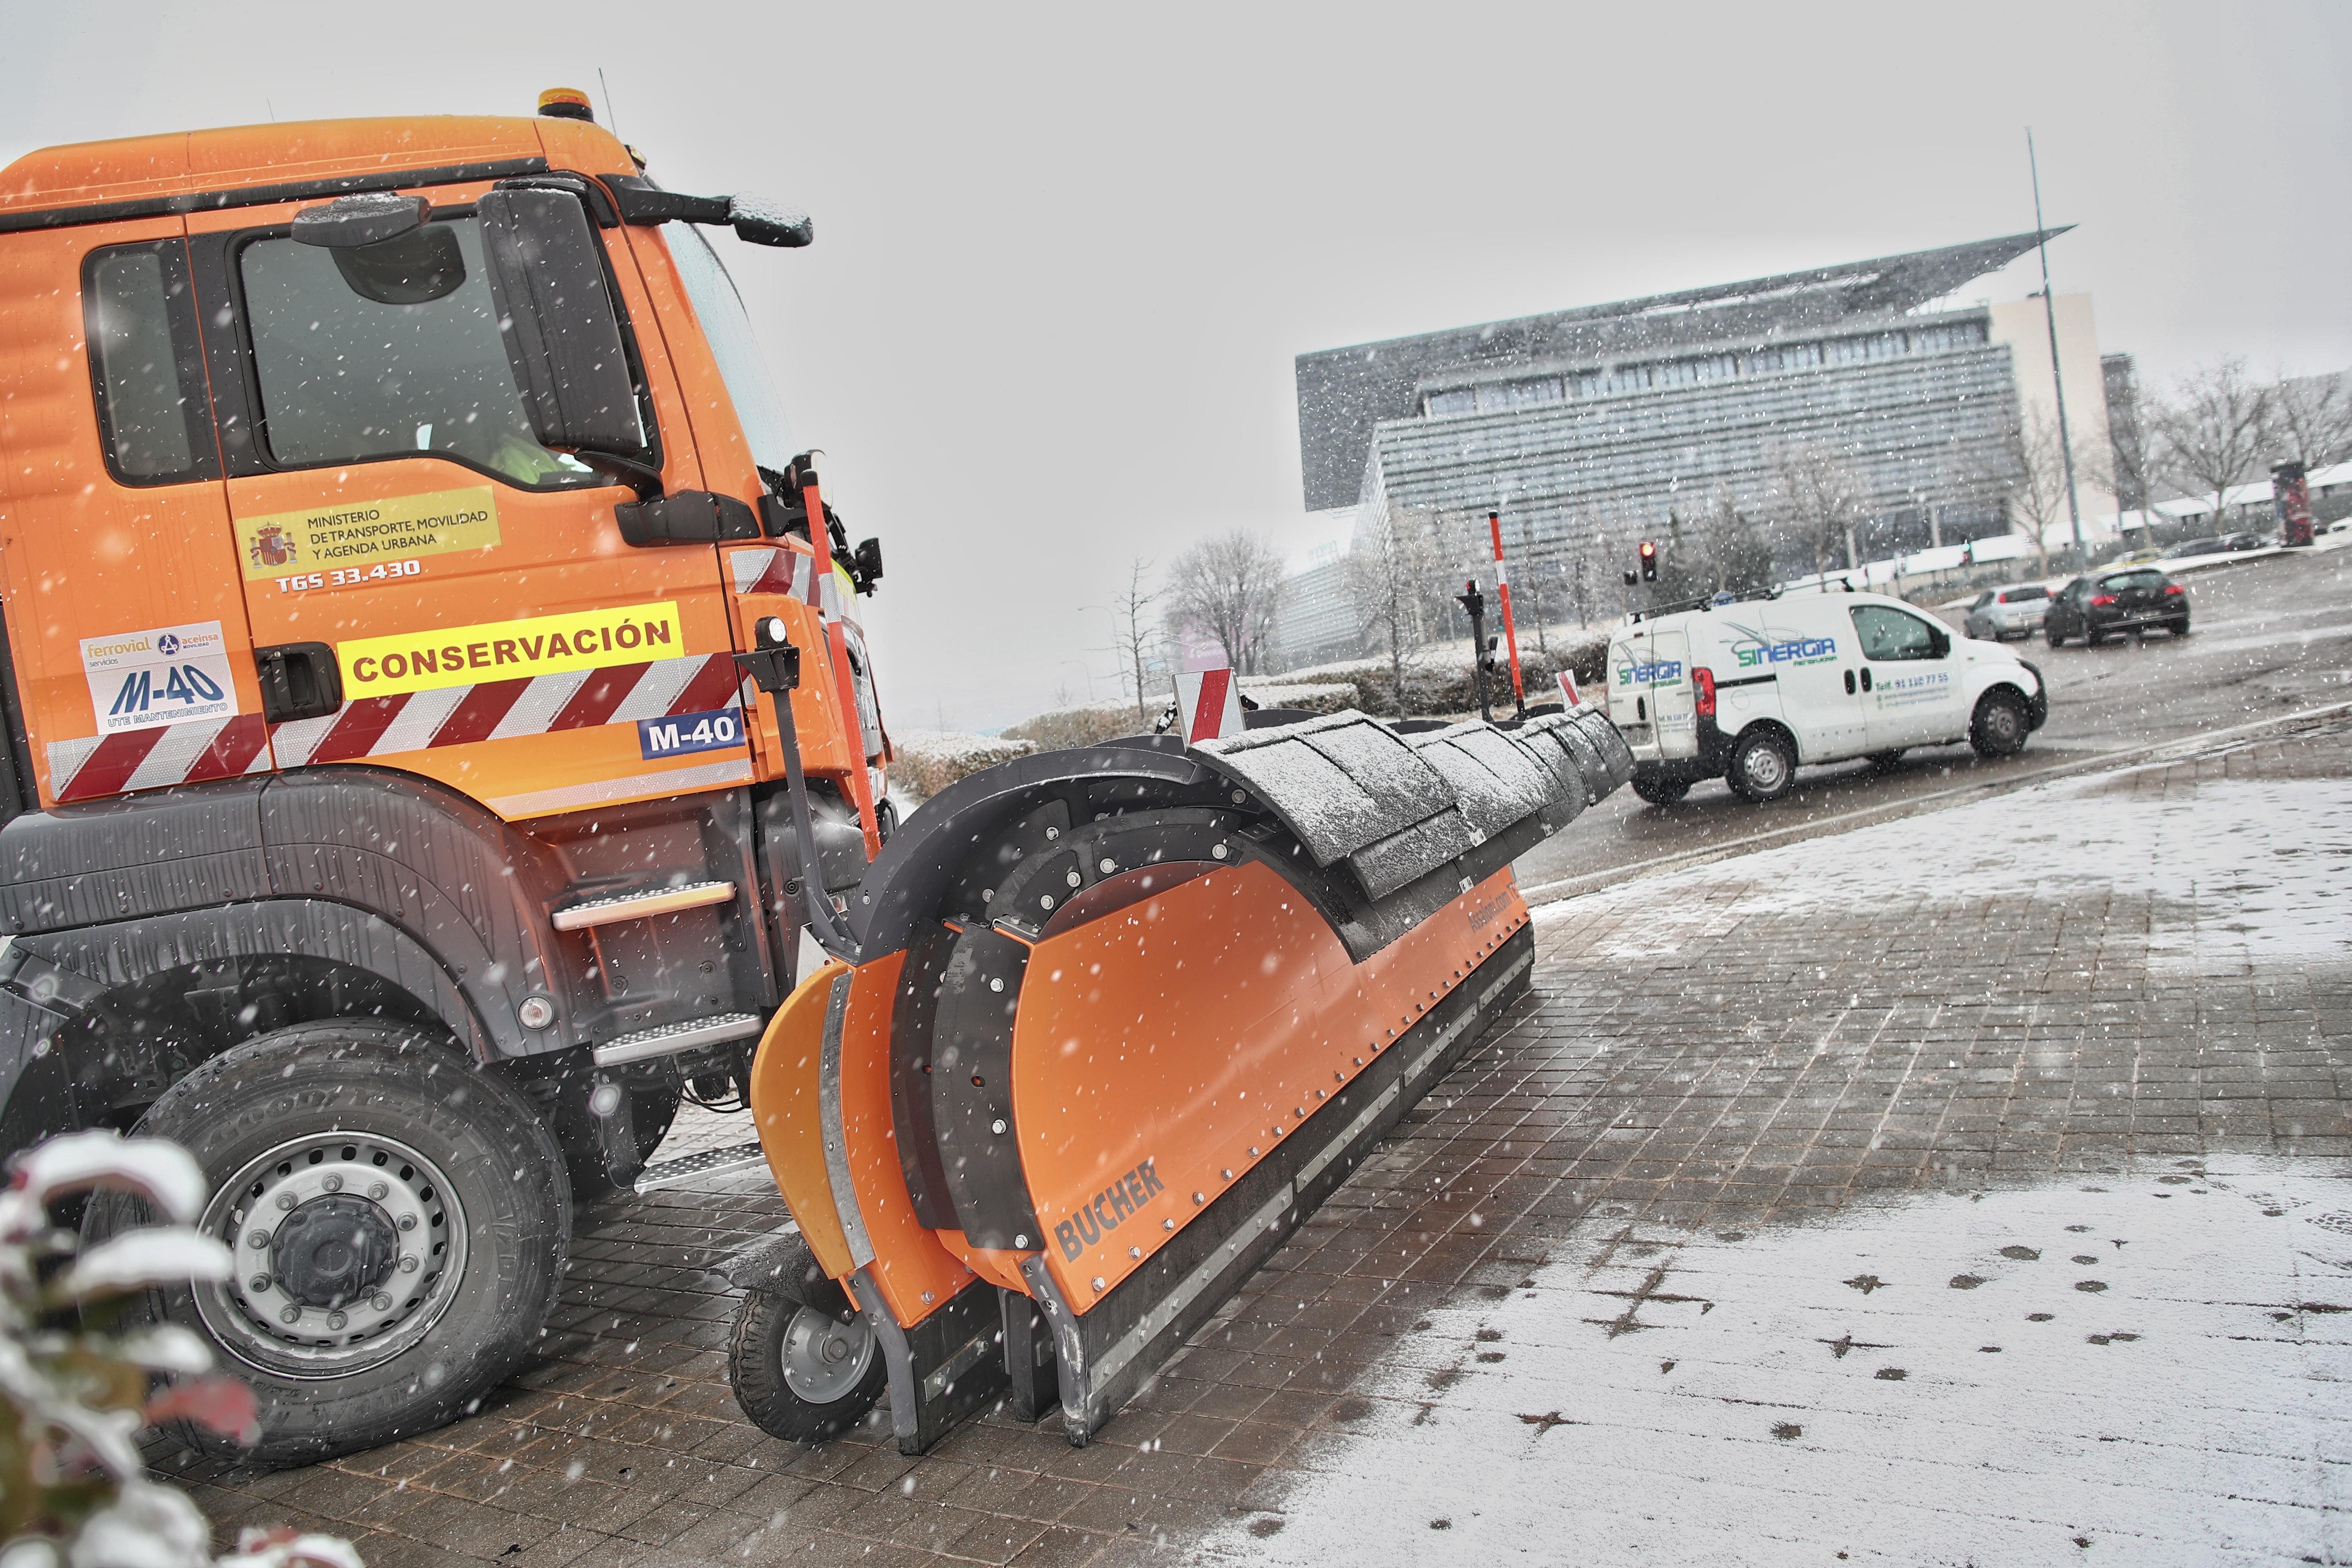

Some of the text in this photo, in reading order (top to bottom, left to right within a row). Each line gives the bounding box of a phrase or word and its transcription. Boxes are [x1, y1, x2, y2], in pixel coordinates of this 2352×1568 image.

[307, 509, 380, 529] MINISTERIO
[310, 510, 488, 545] DE TRANSPORTE, MOVILIDAD
[312, 533, 437, 560] Y AGENDA URBANA
[275, 560, 421, 593] TGS 33.430
[87, 636, 152, 658] ferrovial
[181, 633, 219, 645] aceinsa
[353, 619, 671, 682] CONSERVACIÓN
[89, 658, 119, 668] servicios
[108, 665, 225, 716] M-40
[1926, 674, 1936, 684] 77
[107, 702, 228, 727] UTE MANTENIMIENTO
[648, 716, 735, 752] M-40
[1053, 1160, 1165, 1264] BUCHER
